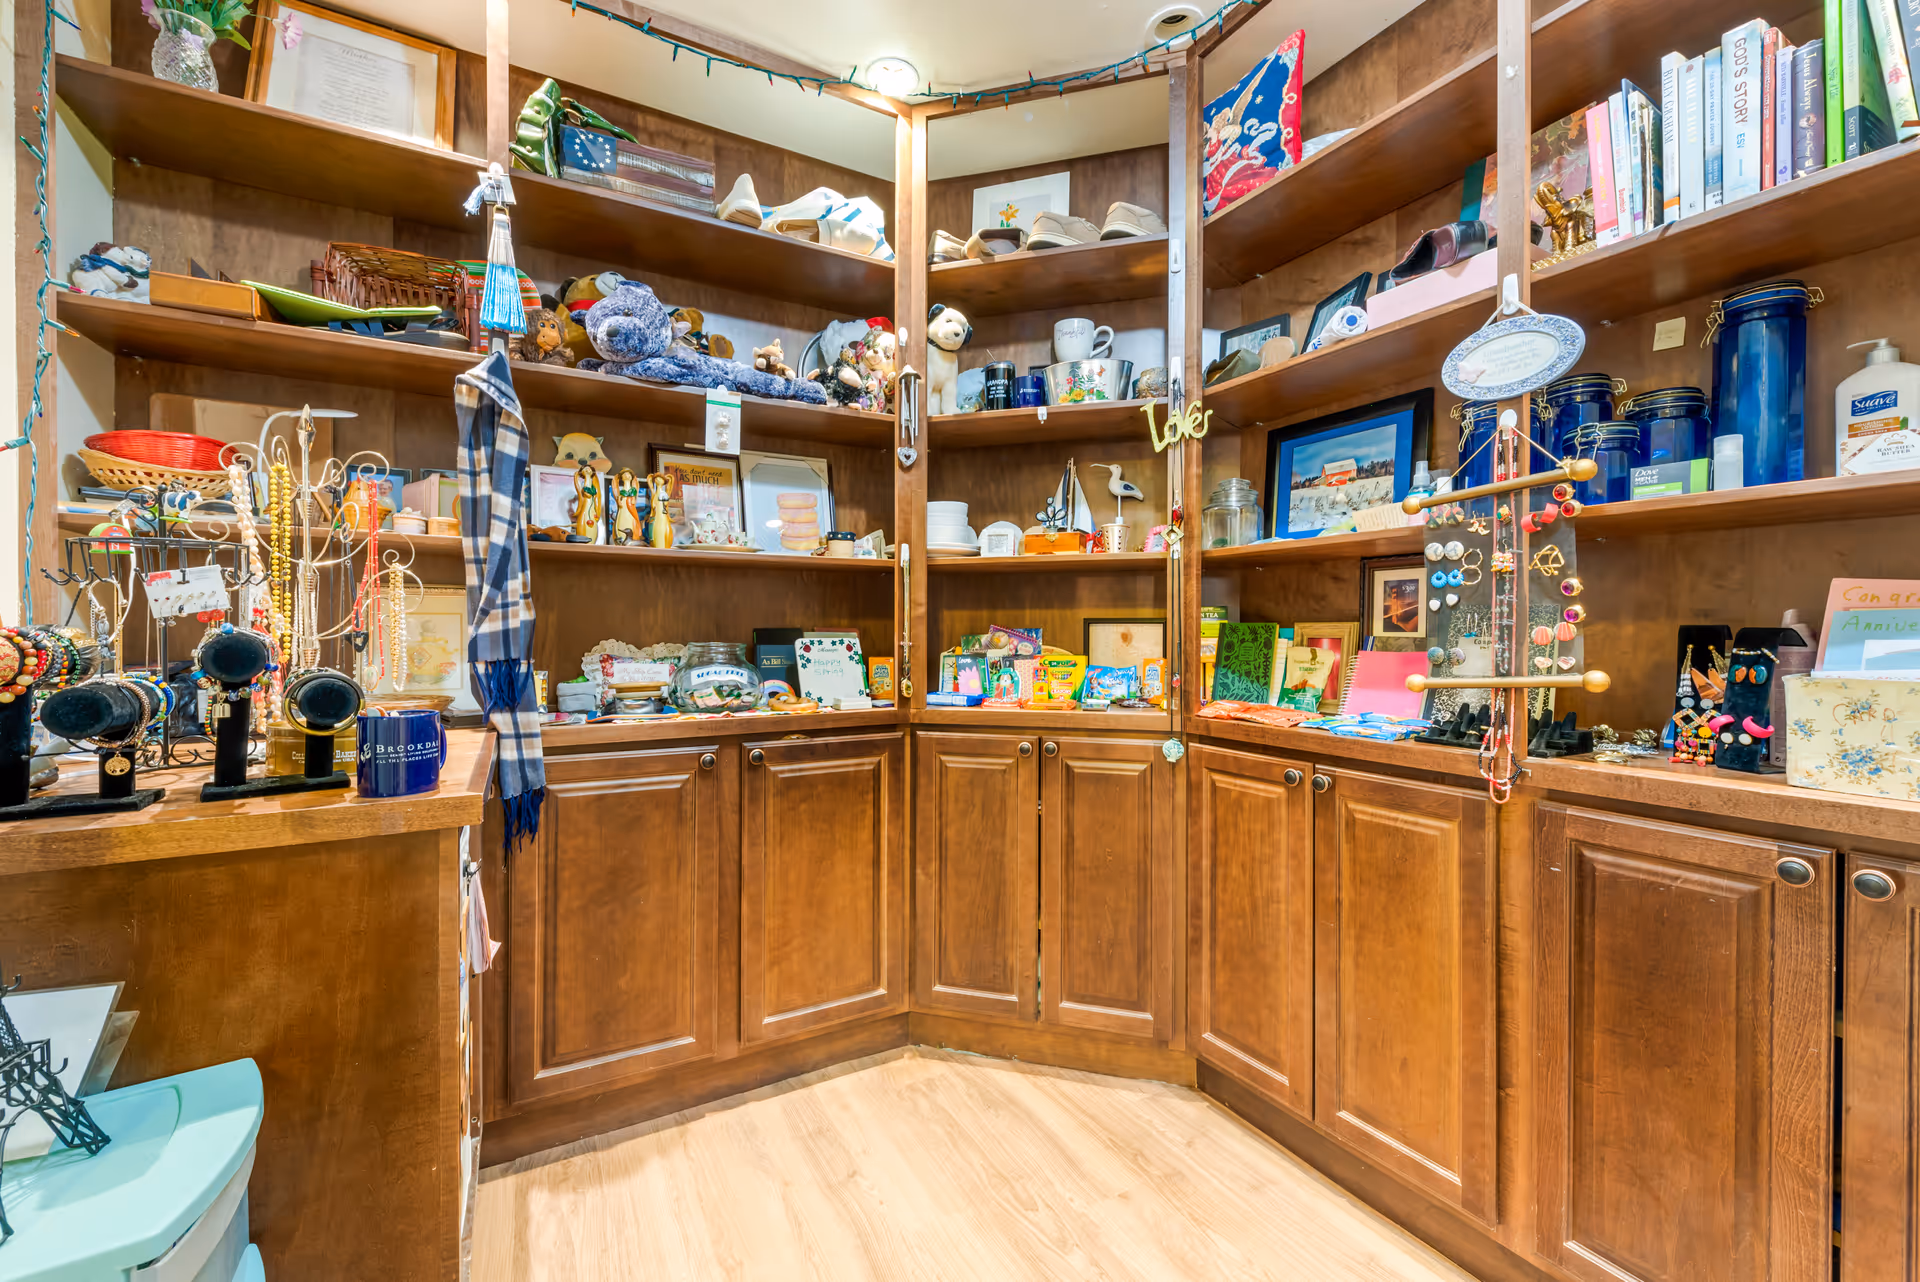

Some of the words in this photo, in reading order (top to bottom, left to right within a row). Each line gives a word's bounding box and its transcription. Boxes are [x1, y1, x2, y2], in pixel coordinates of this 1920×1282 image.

[1734, 37, 1750, 78] GOD'S
[1663, 68, 1674, 99] BILLY
[1799, 78, 1818, 110] Always
[1733, 81, 1749, 124] STORY
[1663, 99, 1675, 146] GRAHAM
[1848, 115, 1857, 137] SCOTT
[1736, 132, 1746, 149] ESV
[1853, 395, 1896, 409] Suave
[679, 473, 690, 483] AS
[692, 475, 719, 485] MUCH
[1634, 468, 1659, 477] Dove
[813, 658, 842, 669] Happy
